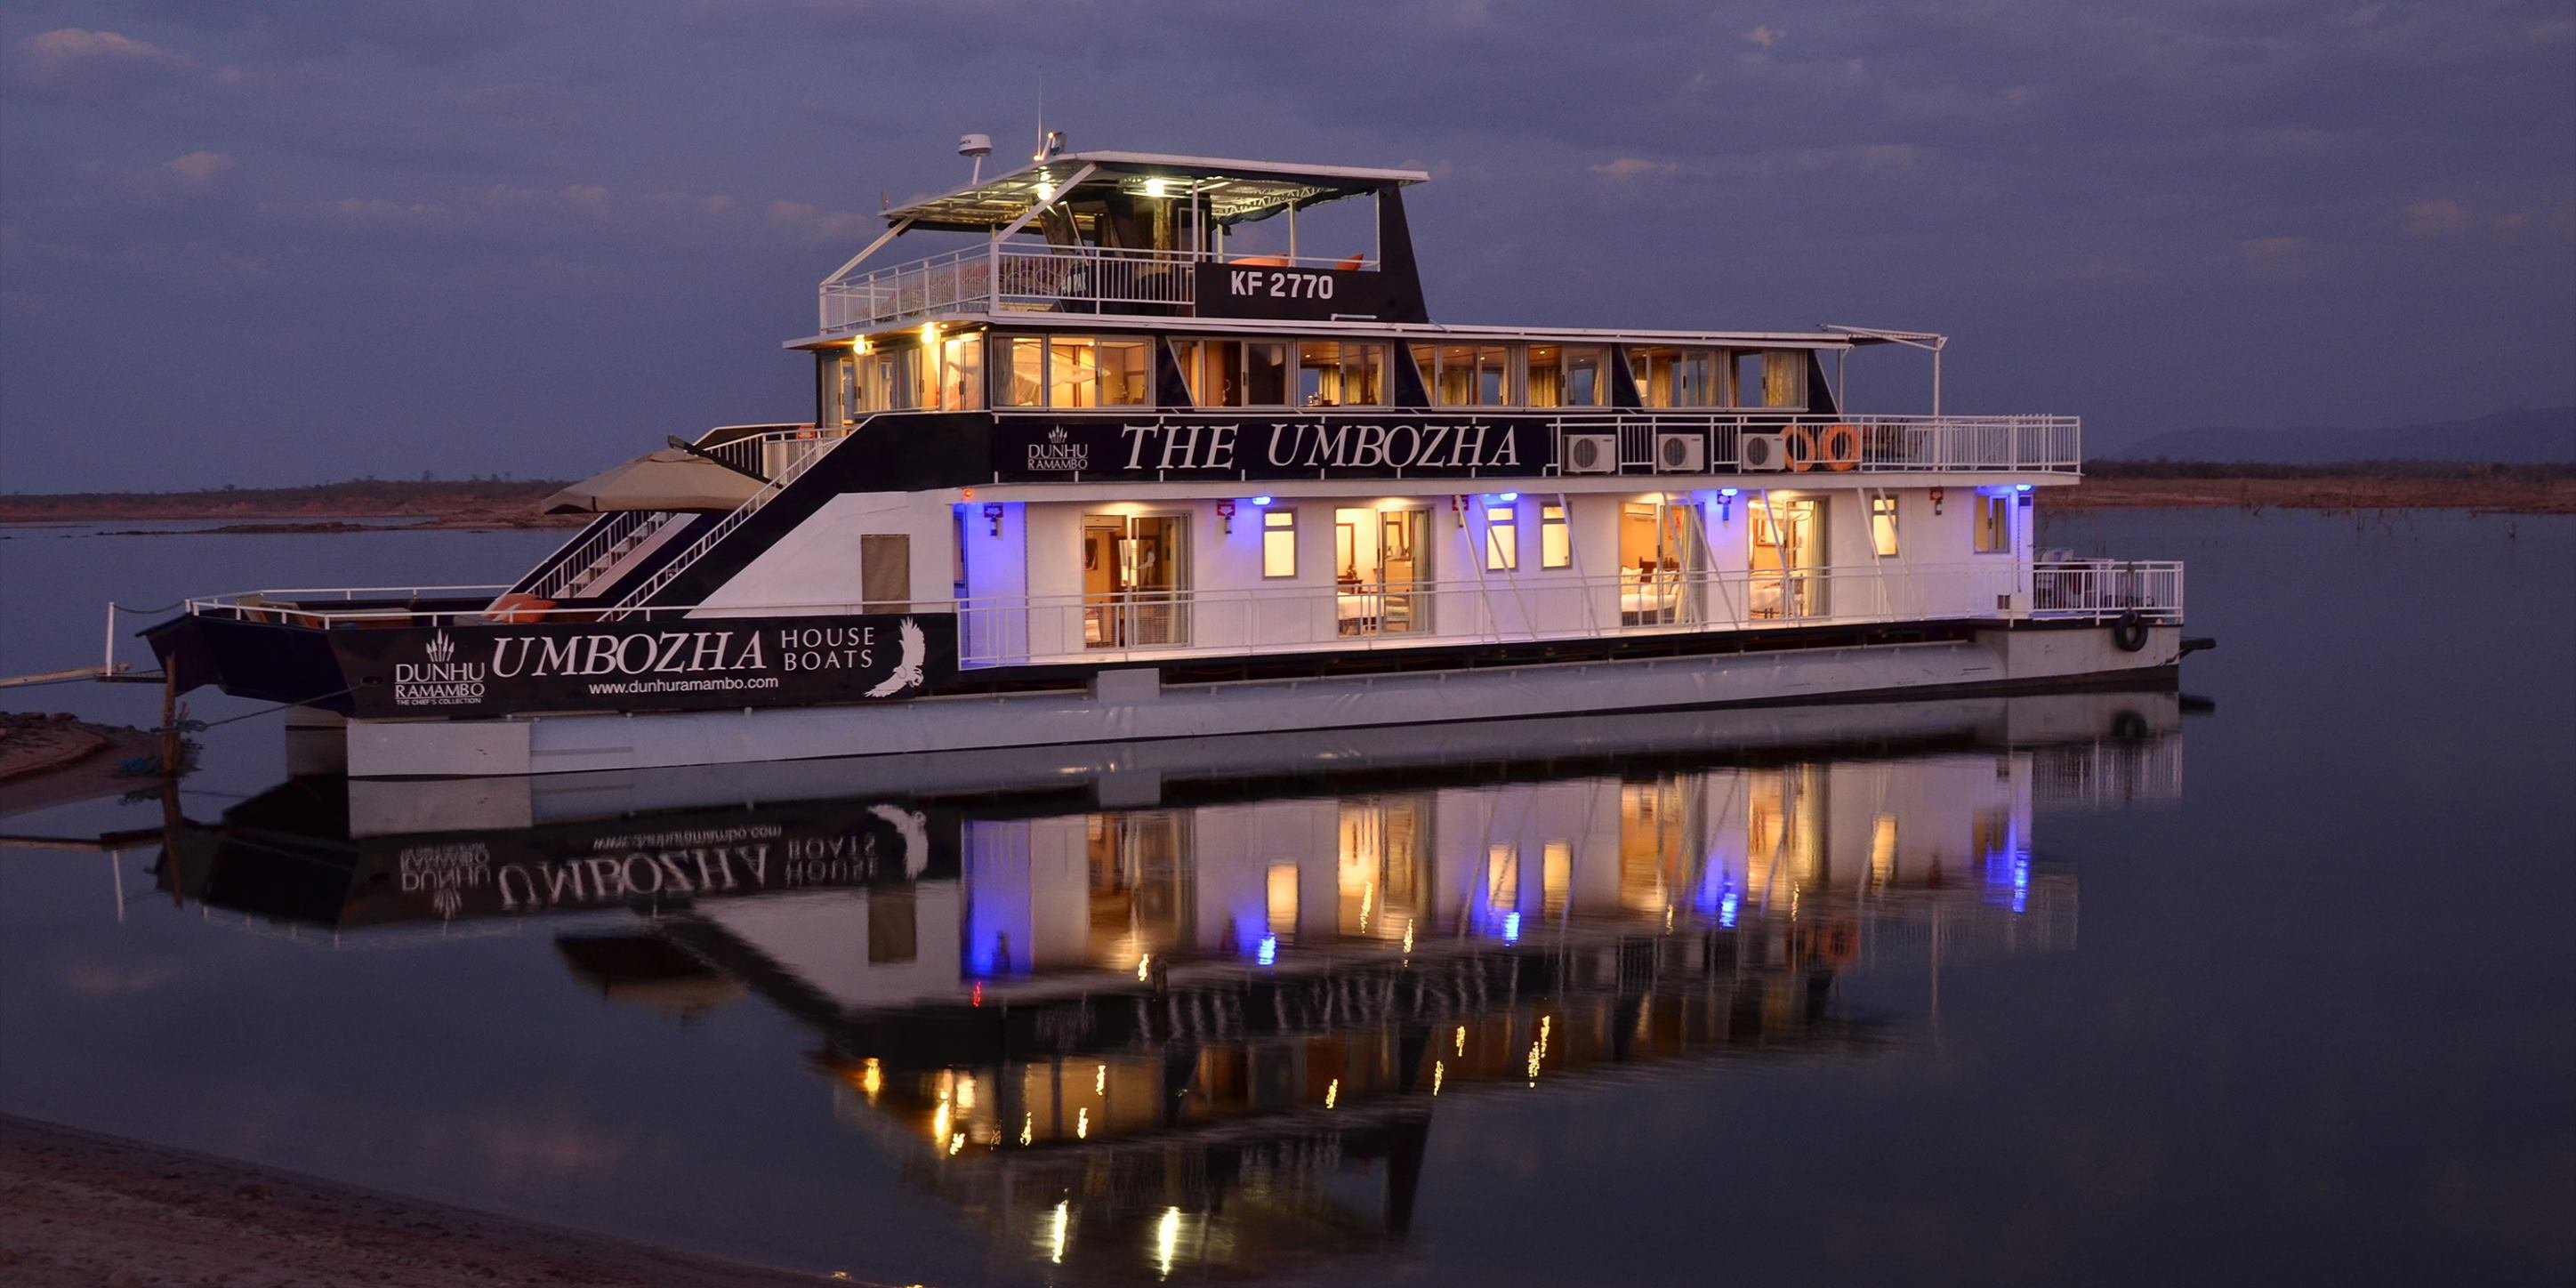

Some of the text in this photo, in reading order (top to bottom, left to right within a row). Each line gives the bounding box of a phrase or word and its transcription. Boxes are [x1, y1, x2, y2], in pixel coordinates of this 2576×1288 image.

[1231, 270, 1333, 300] KF 2770
[1028, 444, 1089, 458] DUNHU
[1121, 423, 1521, 471] THE UMBOZHA
[1027, 458, 1089, 470] RAMAMBO
[781, 626, 875, 649] HOUSE
[492, 630, 767, 678] UMBOZHA
[784, 648, 873, 672] BOATS
[395, 662, 486, 682] DUNHU
[395, 682, 486, 698] RAMAMBO
[588, 676, 779, 695] www.dunhuramambo.com
[438, 697, 481, 705] COLLECTION
